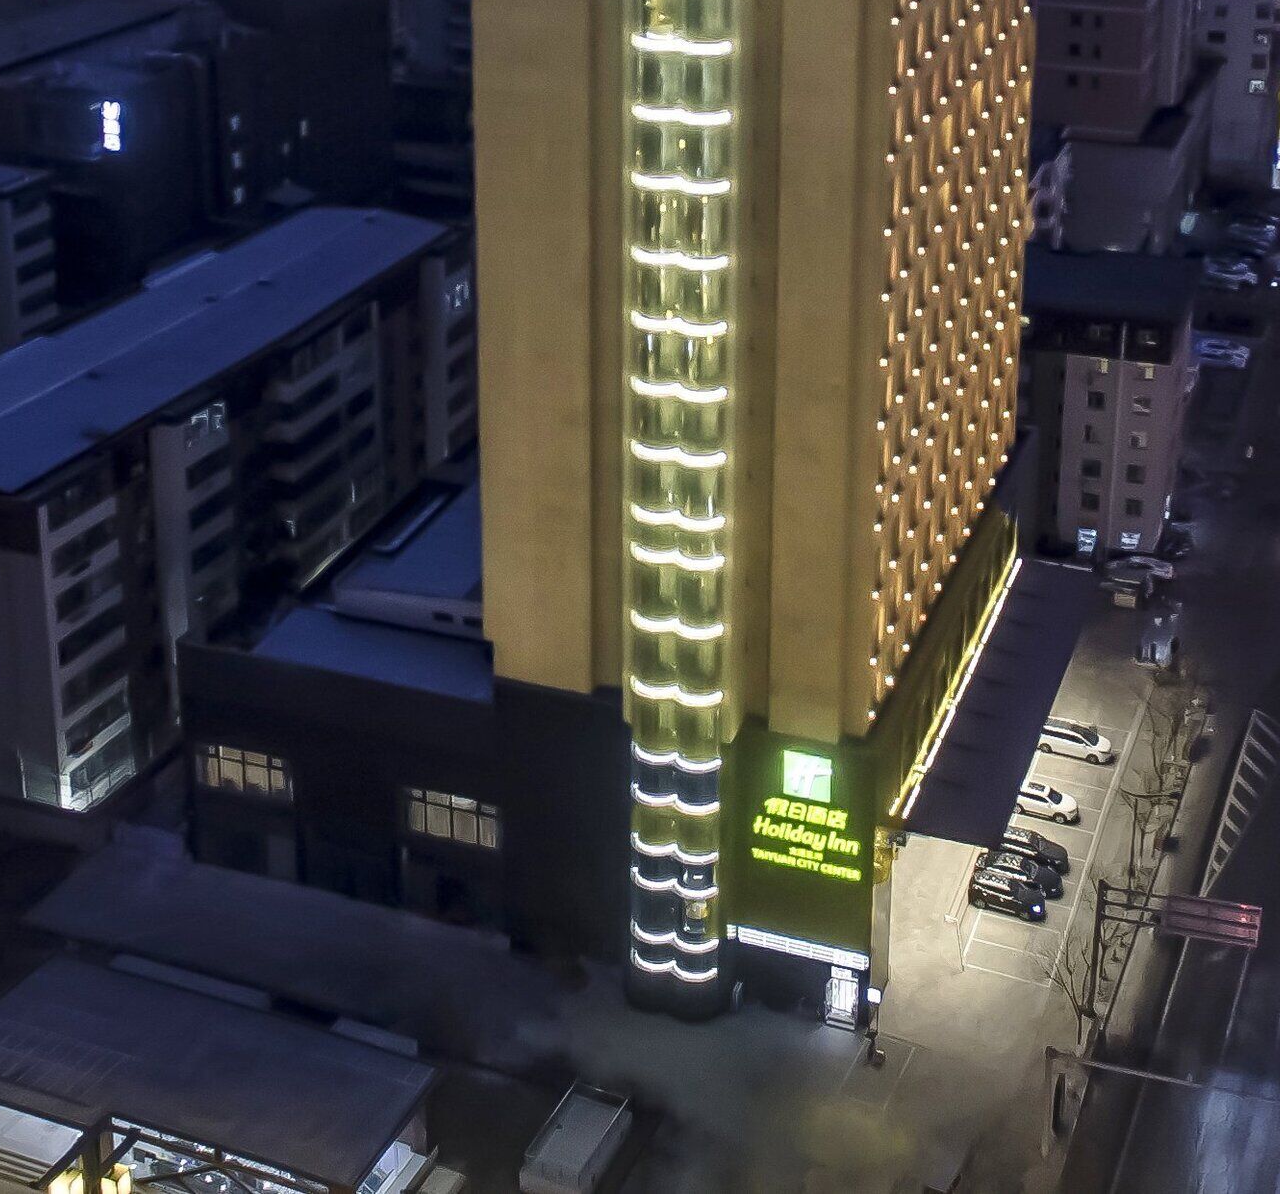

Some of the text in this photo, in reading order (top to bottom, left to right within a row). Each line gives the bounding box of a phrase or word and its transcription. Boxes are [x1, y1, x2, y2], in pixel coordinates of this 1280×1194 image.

[764, 797, 848, 830] 假日酒店
[753, 815, 827, 851] Holiday
[827, 831, 861, 856] Inn
